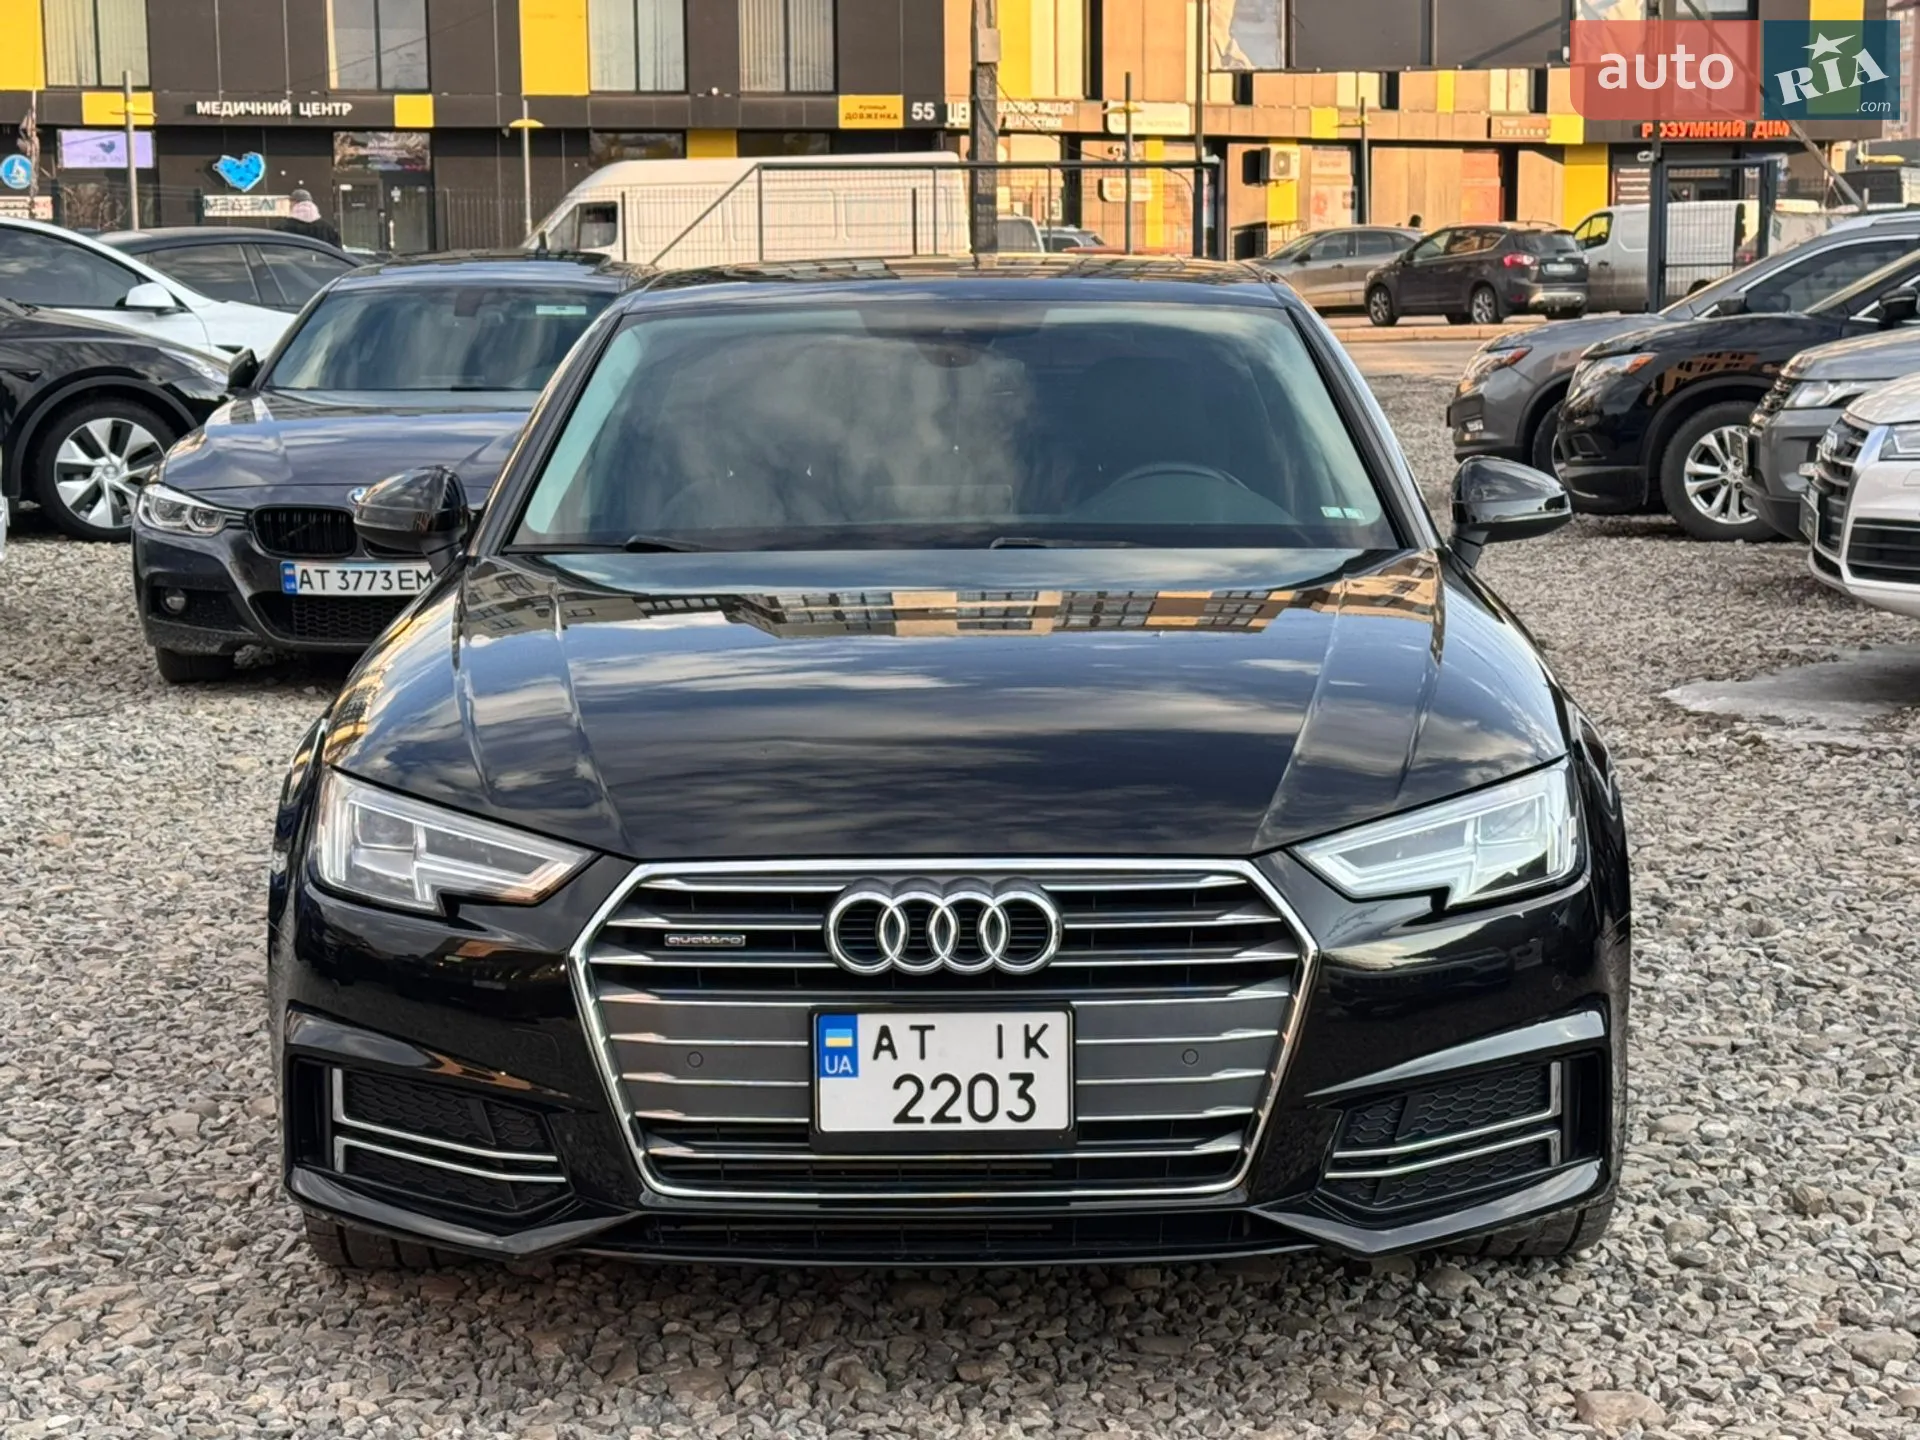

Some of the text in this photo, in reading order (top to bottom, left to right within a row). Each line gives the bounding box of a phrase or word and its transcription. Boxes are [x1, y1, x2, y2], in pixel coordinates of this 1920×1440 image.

[196, 99, 353, 118] МЕДИЧНИЙ ЦЕНТР
[845, 112, 898, 121] ДОВЖЕНКА
[911, 102, 936, 121] 55
[1752, 121, 1790, 139] ДІМ
[300, 569, 434, 591] AT 3773 EM
[668, 936, 741, 946] quattro
[873, 1023, 1049, 1060] AT IK
[825, 1056, 853, 1074] UA
[893, 1072, 1036, 1124] 2203
